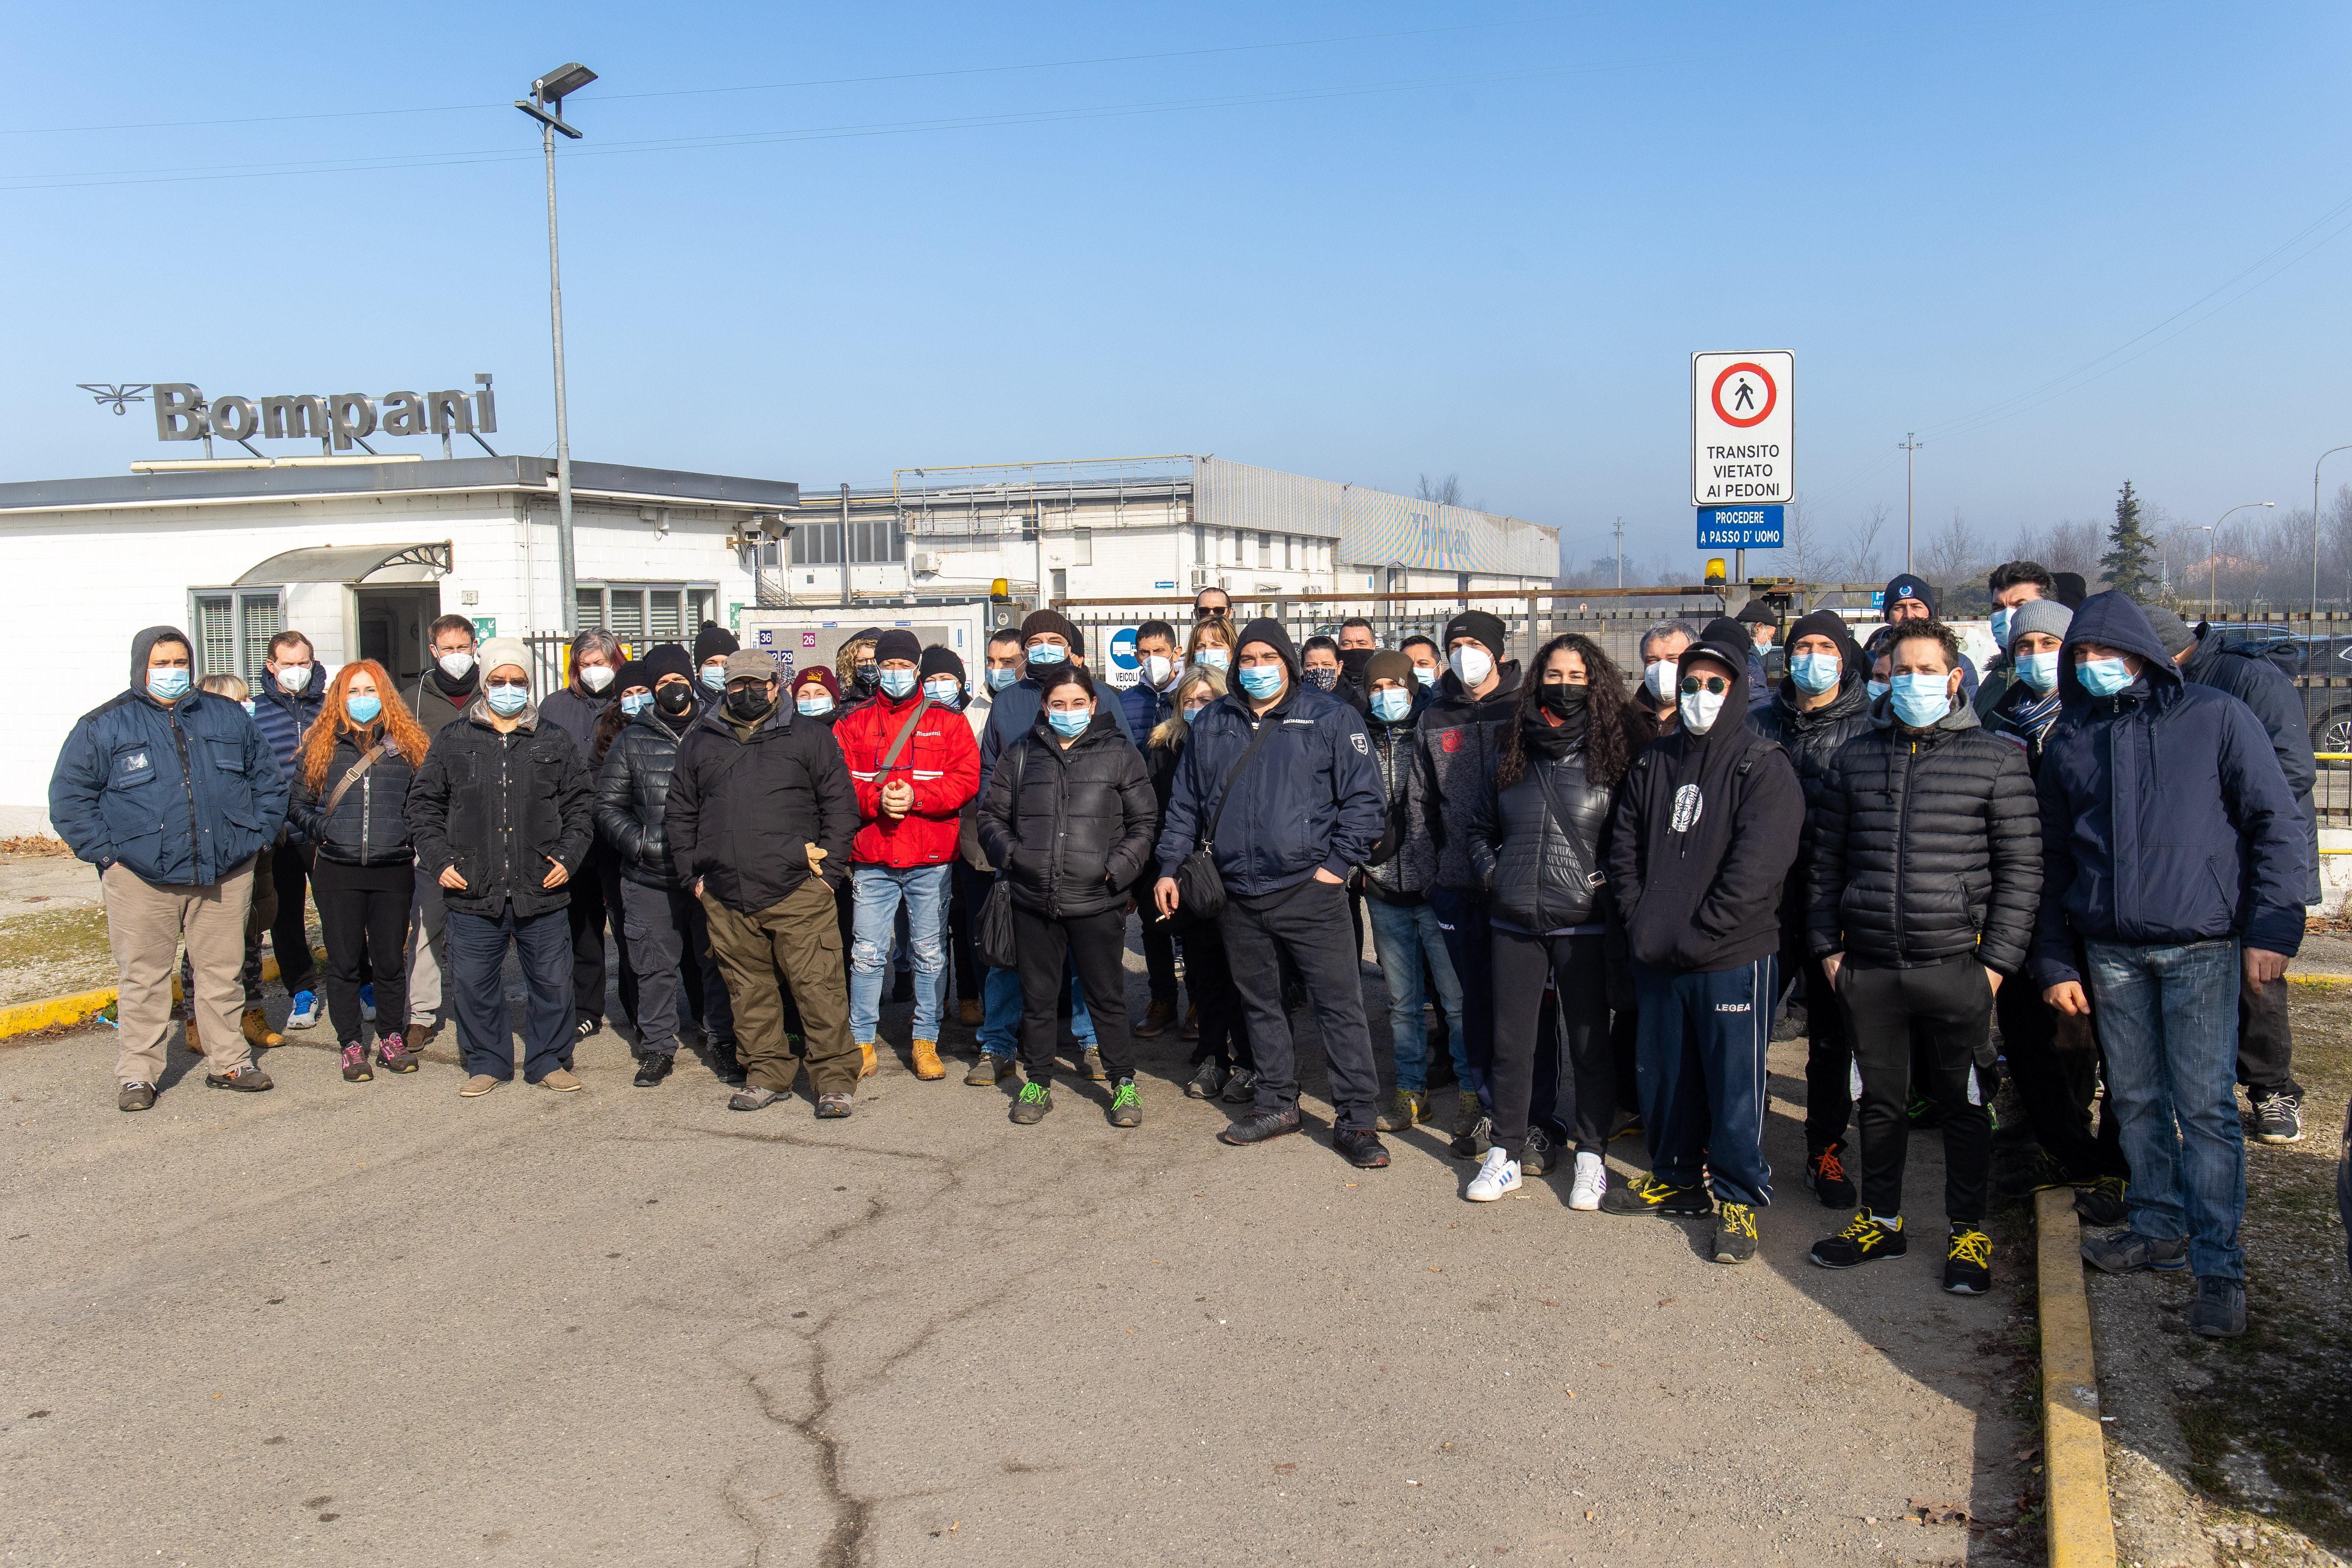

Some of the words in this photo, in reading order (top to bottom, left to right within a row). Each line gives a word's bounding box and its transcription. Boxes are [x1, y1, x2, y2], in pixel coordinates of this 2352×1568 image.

[153, 374, 497, 450] Bompani
[1707, 444, 1779, 459] TRANSITO
[1713, 464, 1773, 478] VIETATO
[1707, 484, 1721, 497] AI
[1725, 483, 1779, 497] PEDONI
[1715, 511, 1764, 524] PROCEDERE
[1700, 532, 1706, 543] A
[1710, 531, 1740, 543] PASSO
[1755, 530, 1779, 542] UOMO
[760, 633, 772, 643] 36
[803, 635, 815, 645] 26
[781, 652, 793, 663] 29
[1115, 672, 1138, 682] VEICOLI
[1715, 1003, 1751, 1012] LEGEA
